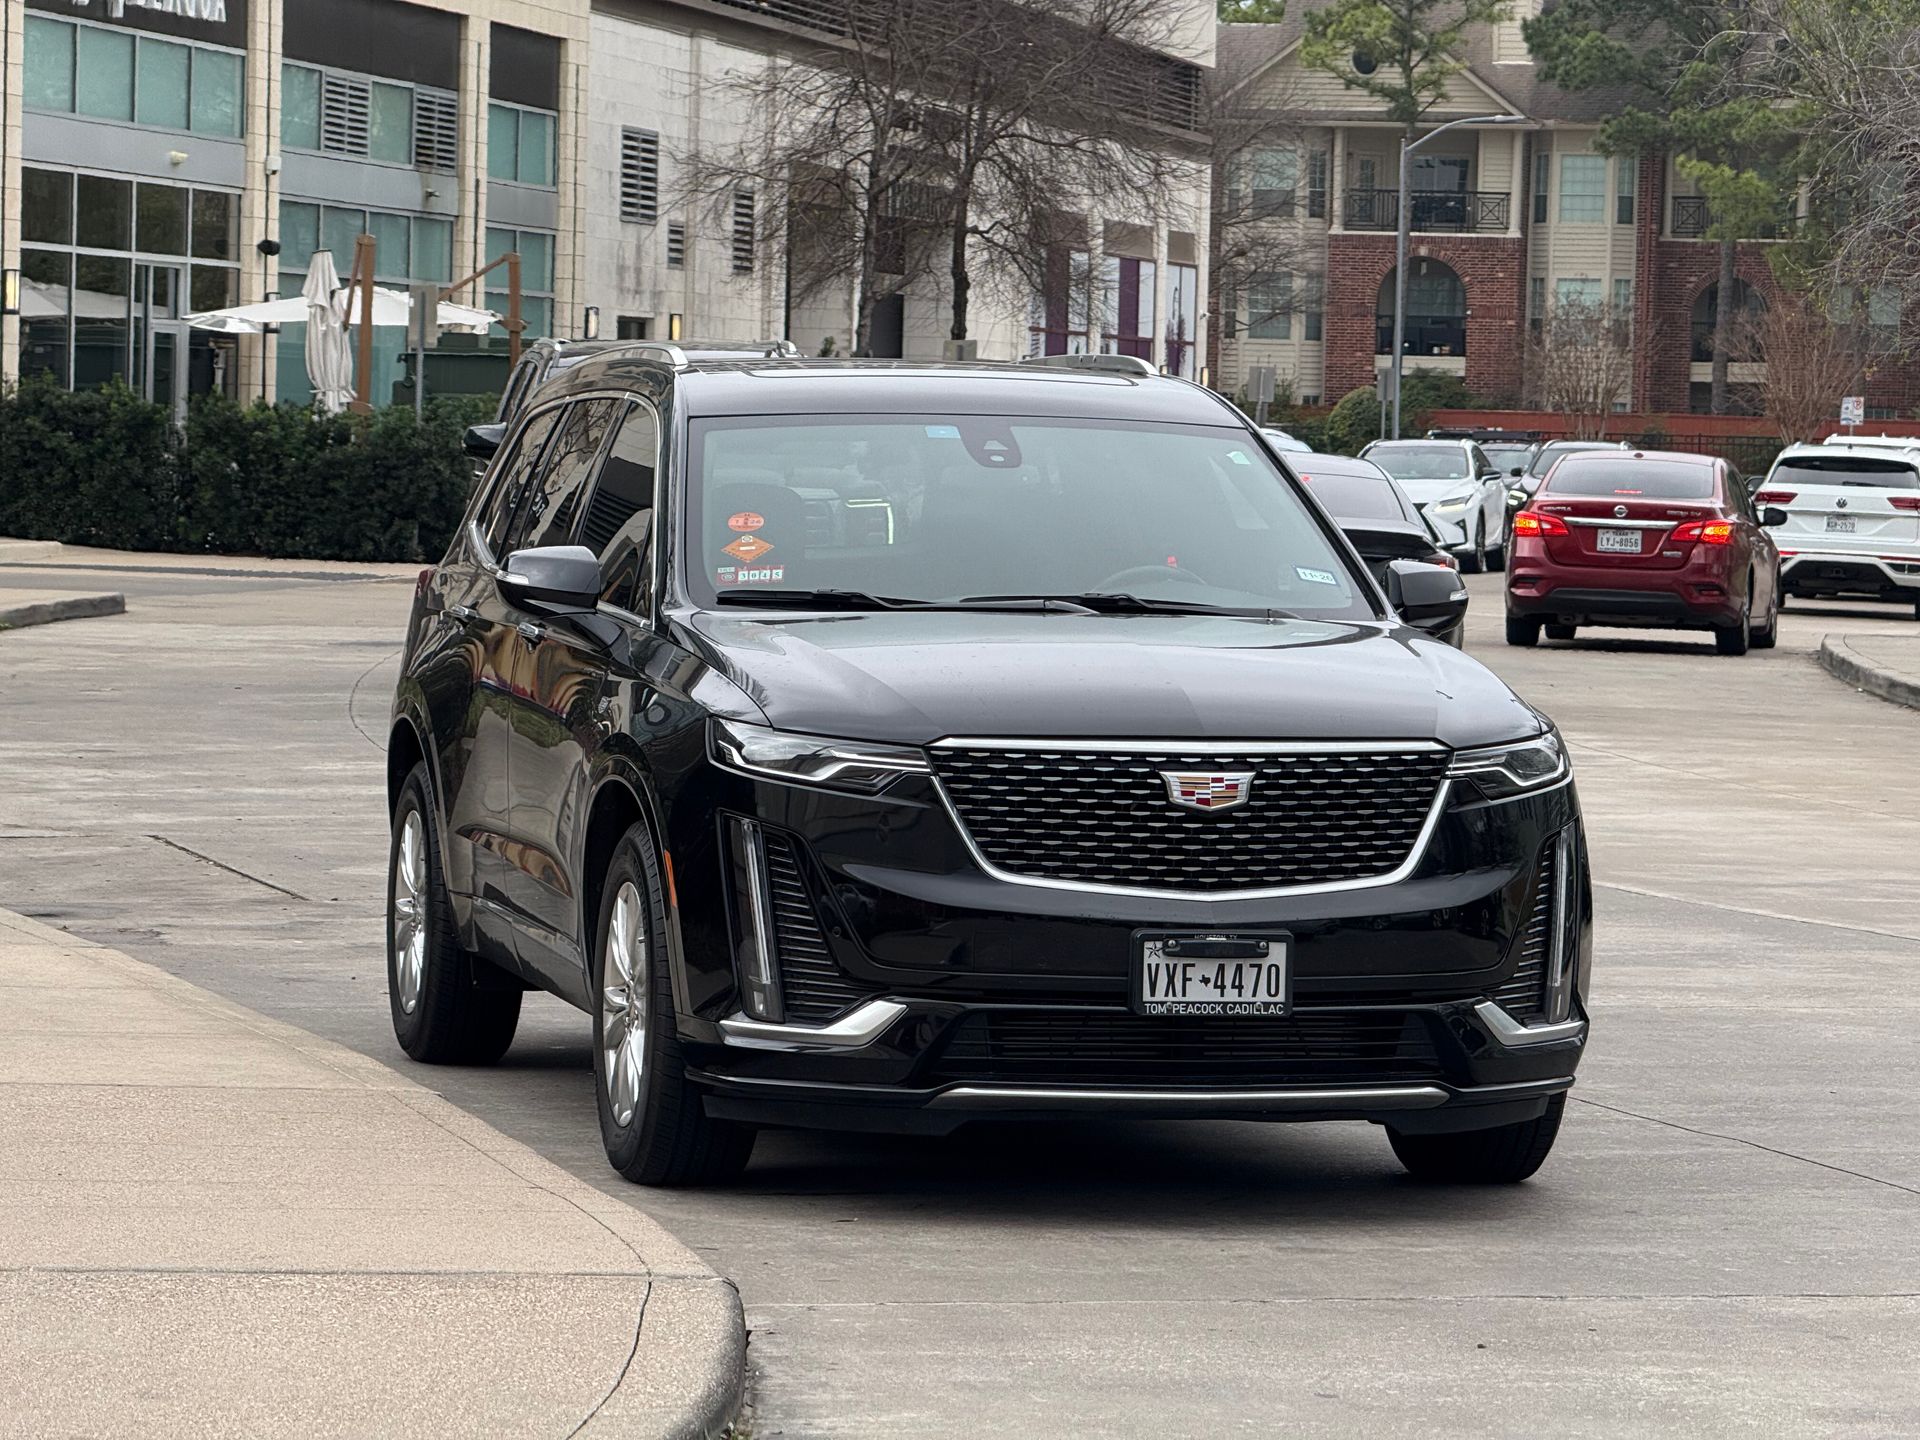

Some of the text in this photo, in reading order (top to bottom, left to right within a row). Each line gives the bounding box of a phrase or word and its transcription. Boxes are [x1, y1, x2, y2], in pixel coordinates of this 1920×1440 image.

[1147, 963, 1281, 998] VXF 4470
[1144, 1003, 1285, 1015] TOM PEACOCK CADILLAC
